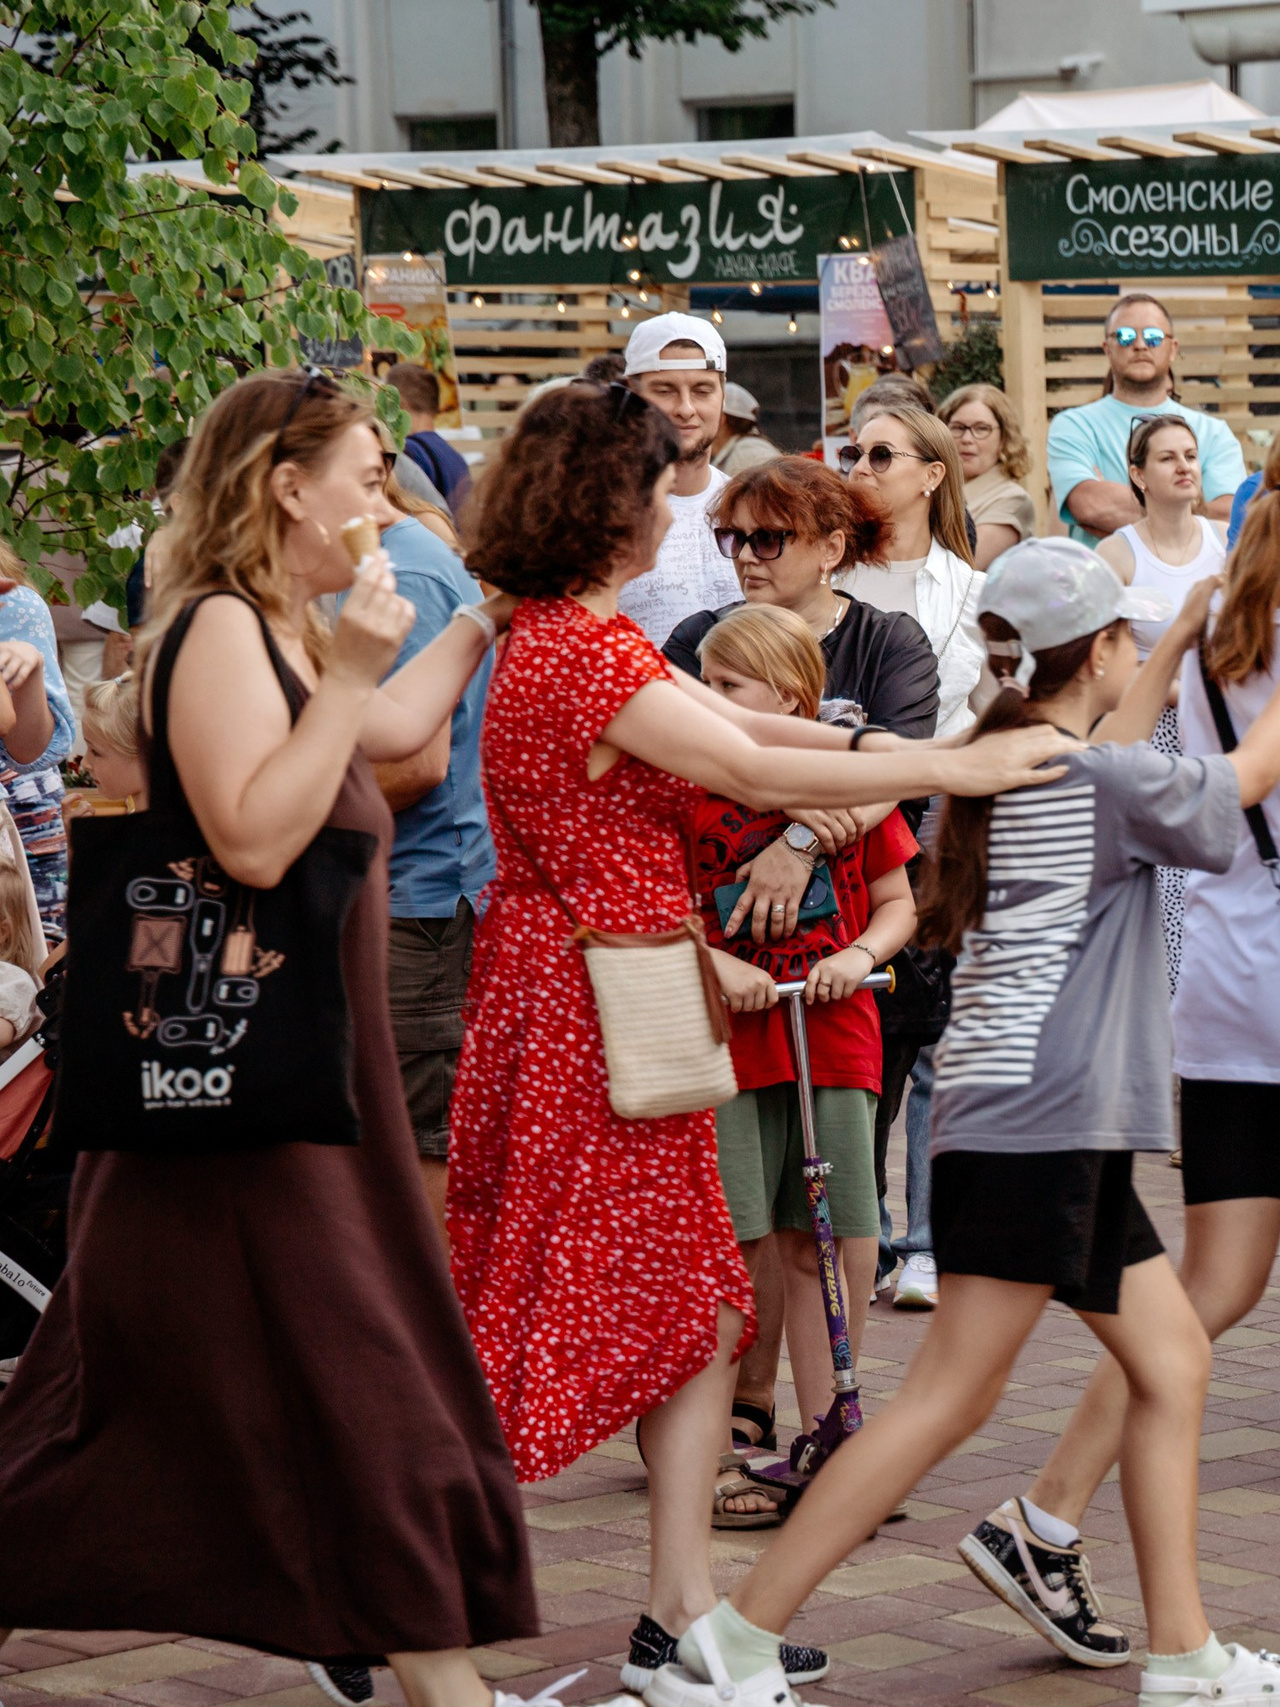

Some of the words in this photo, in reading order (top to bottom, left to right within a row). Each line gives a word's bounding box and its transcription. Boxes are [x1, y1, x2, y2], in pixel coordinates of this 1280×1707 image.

[1065, 172, 1275, 215] Смоленские
[1109, 222, 1240, 259] сезоны
[141, 1060, 233, 1099] ikoo
